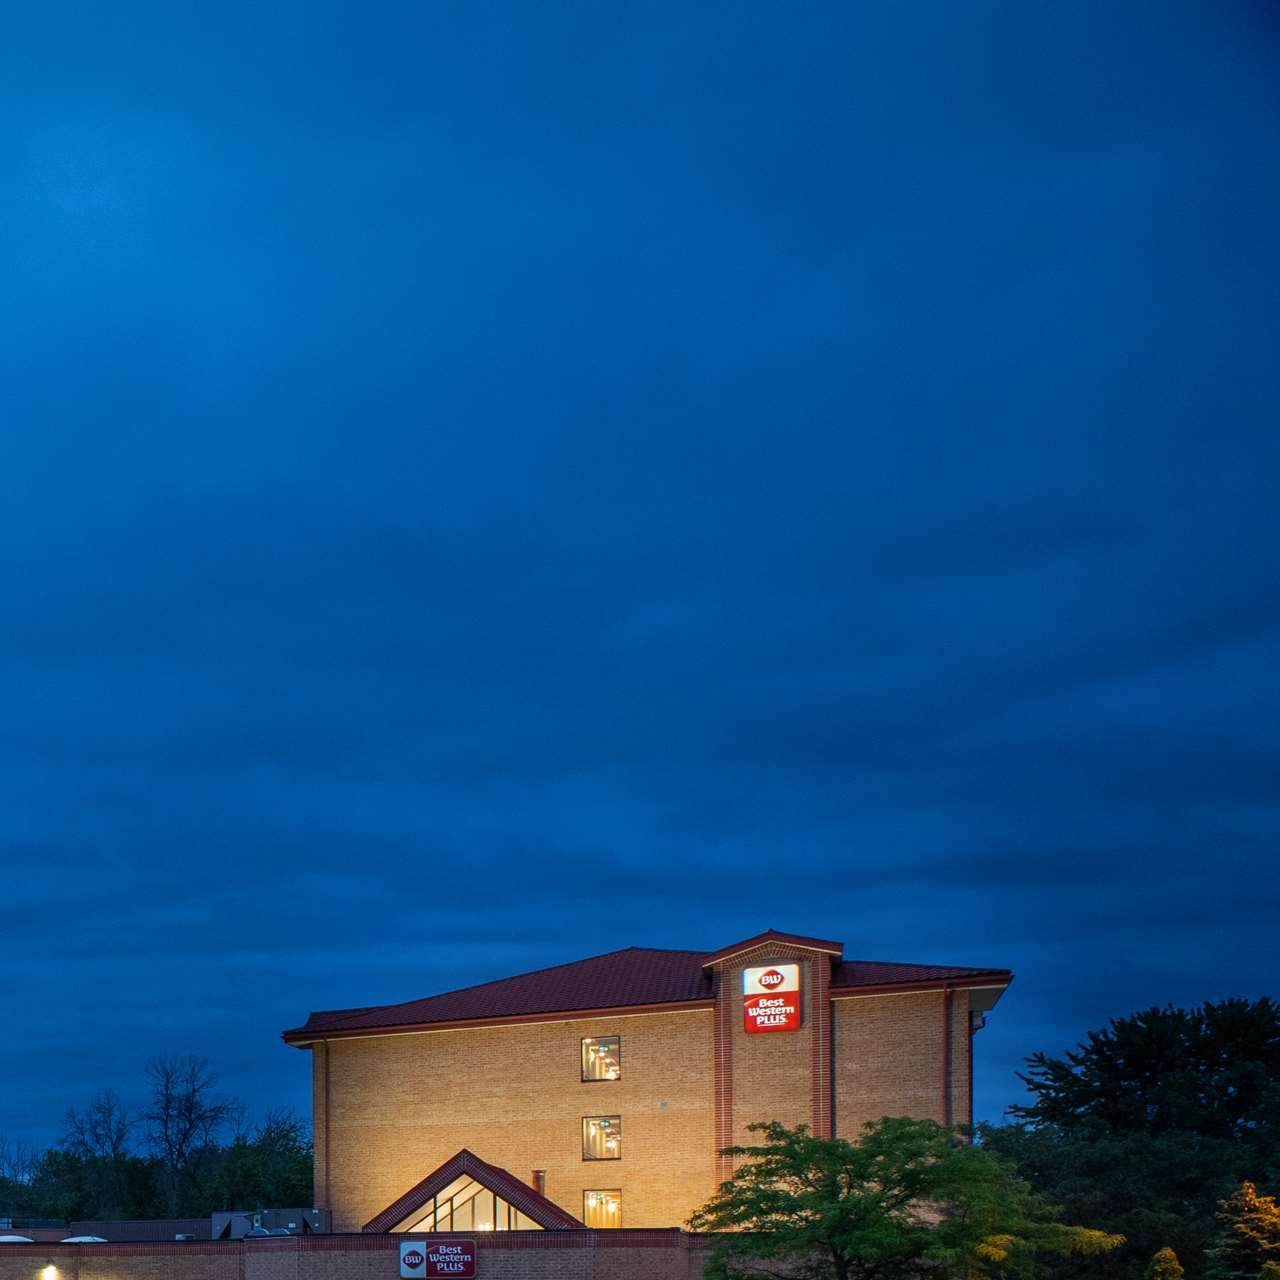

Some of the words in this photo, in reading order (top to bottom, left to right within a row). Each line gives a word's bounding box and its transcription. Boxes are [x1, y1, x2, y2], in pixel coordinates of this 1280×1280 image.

[761, 975, 781, 985] BW
[759, 998, 784, 1007] Best
[748, 1006, 794, 1016] Western
[439, 1245, 462, 1254] Best
[405, 1255, 422, 1264] BW
[429, 1254, 472, 1262] Western
[437, 1262, 464, 1271] PLUS
